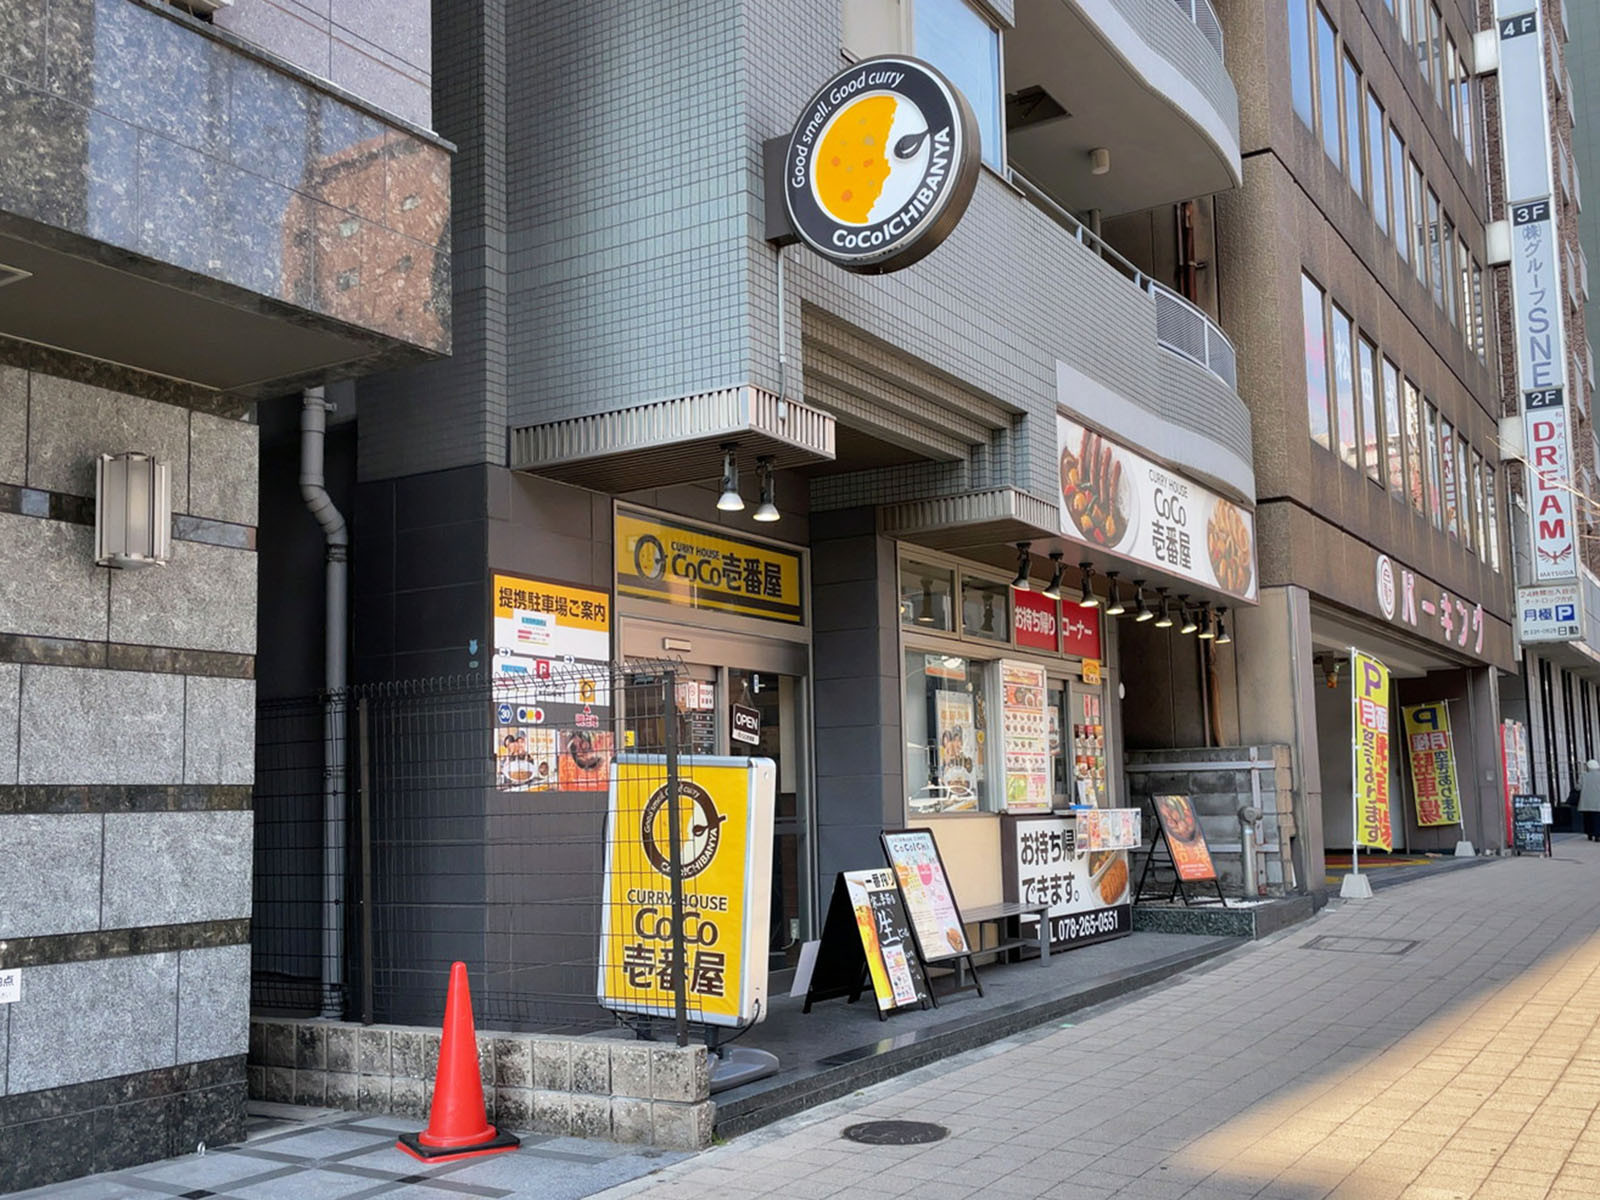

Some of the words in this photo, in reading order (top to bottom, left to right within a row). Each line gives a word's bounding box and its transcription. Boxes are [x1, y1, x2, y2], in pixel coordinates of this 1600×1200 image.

[791, 144, 808, 189] Good
[802, 100, 832, 144] smell.
[830, 71, 866, 105] Good
[868, 71, 905, 89] curry
[832, 127, 950, 249] CoCoICHIBANYA
[1516, 204, 1546, 222] 3F
[1531, 390, 1557, 407] 2F
[1148, 468, 1168, 489] CURRY
[1168, 479, 1188, 499] HOUSE
[1532, 420, 1566, 541] DREAM
[1153, 487, 1187, 527] CoCo
[671, 541, 695, 555] CURRY
[696, 547, 720, 562] HOUSE
[1151, 520, 1192, 570] 壱番屋
[498, 586, 607, 623] 提携駐車場ご案内
[1015, 605, 1056, 636] お持ち帰り
[1062, 616, 1093, 640] コーナー
[735, 712, 759, 730] OPEN
[1021, 829, 1085, 866] お持ち帰
[627, 889, 672, 905] CURRY
[1022, 872, 1080, 905] できます。
[635, 907, 719, 947] CoCo
[1035, 922, 1057, 943] TL
